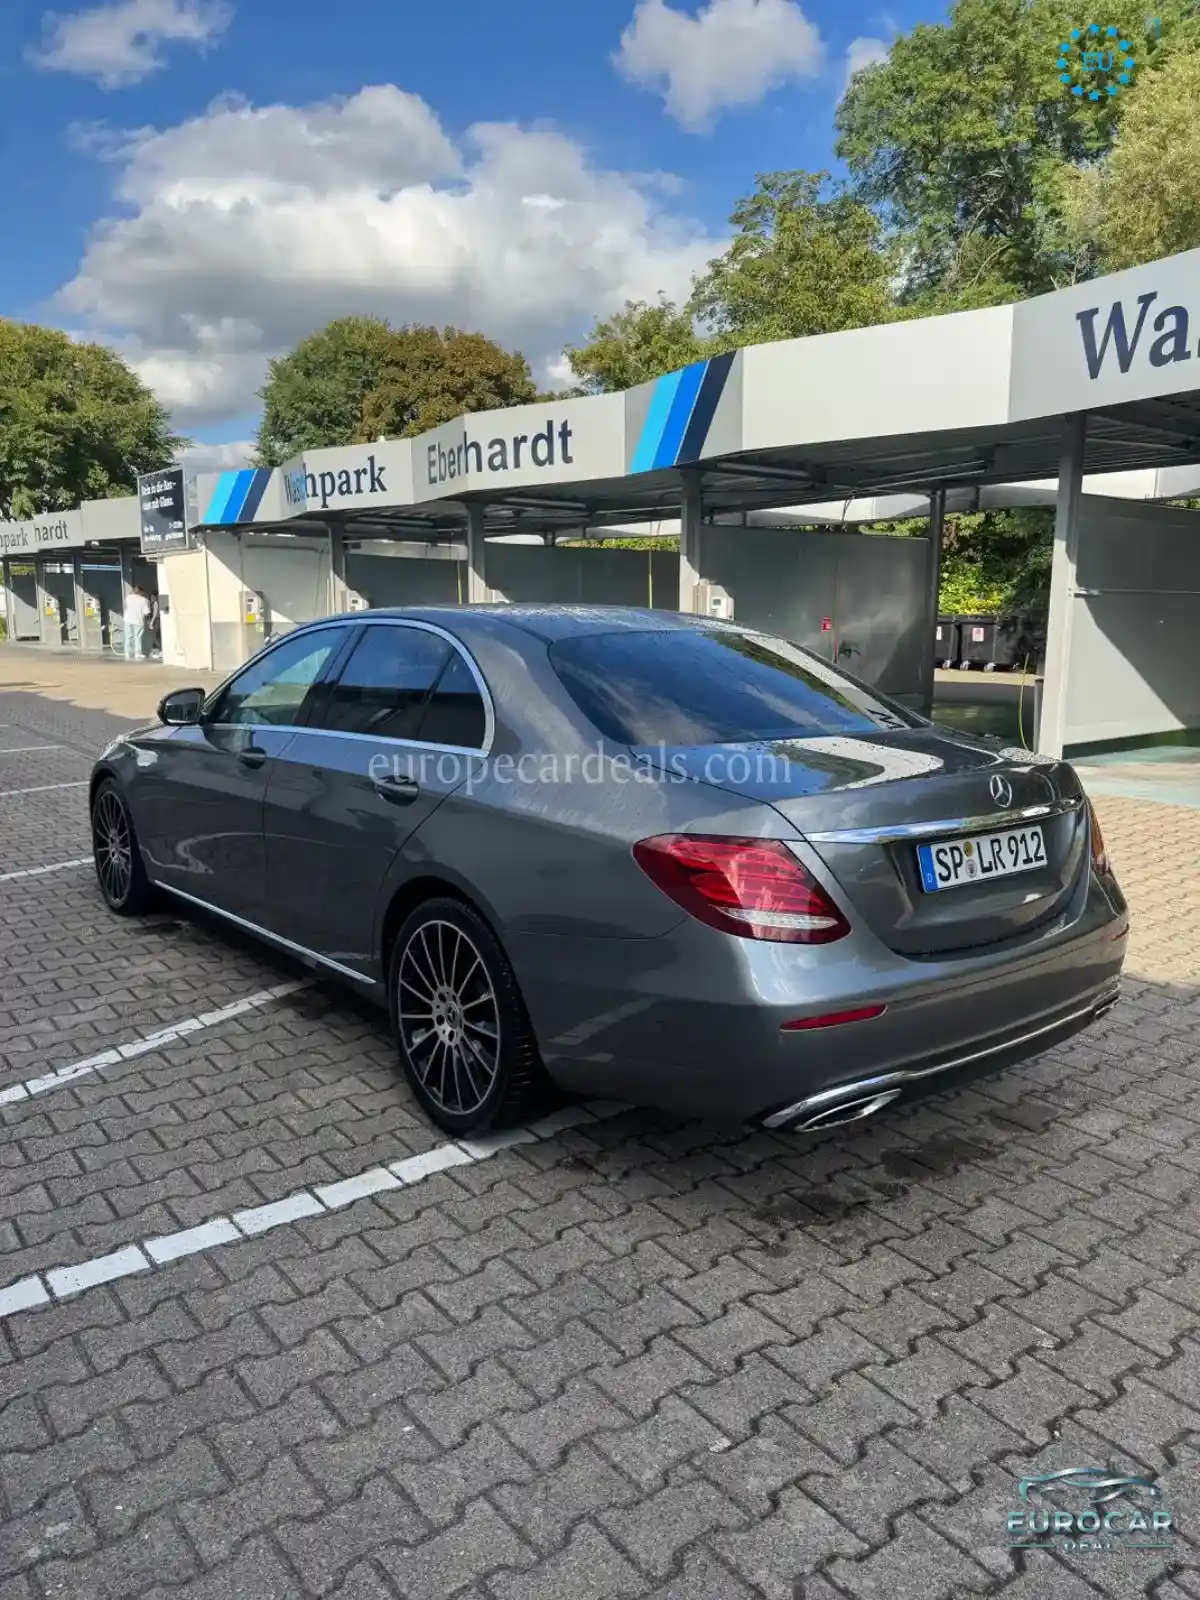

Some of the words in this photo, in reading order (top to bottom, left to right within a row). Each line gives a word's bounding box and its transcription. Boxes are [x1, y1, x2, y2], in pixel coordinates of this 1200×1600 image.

[1075, 291, 1200, 380] Wa
[427, 419, 574, 485] Eberhardt
[935, 843, 964, 882] SP
[976, 838, 1006, 874] LR
[1007, 831, 1045, 868] 912
